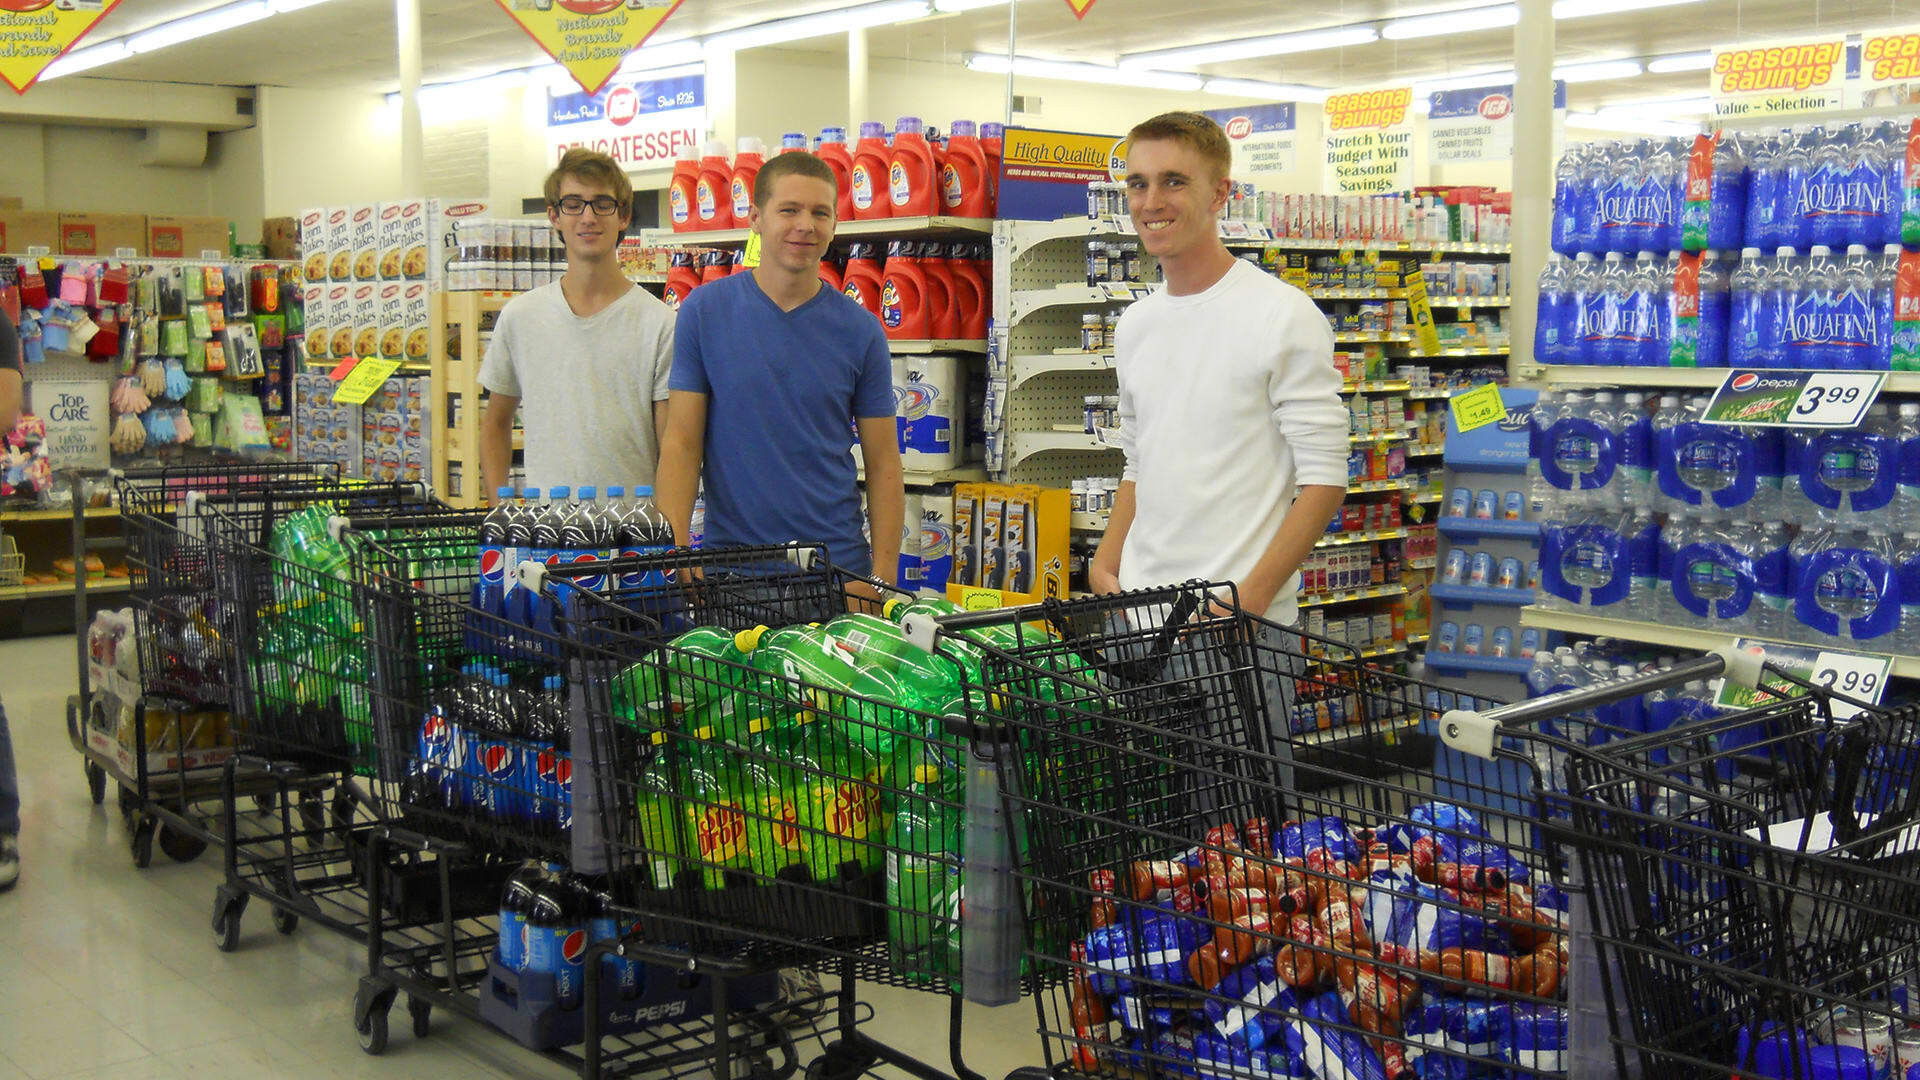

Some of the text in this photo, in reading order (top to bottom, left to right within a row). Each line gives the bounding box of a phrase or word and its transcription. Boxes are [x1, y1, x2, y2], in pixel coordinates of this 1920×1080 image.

[0, 11, 58, 26] ational
[557, 12, 629, 32] National
[0, 27, 52, 42] rands
[565, 28, 623, 46] Brands
[556, 49, 590, 63] And
[1714, 41, 1844, 74] seasonal
[1721, 63, 1833, 93] savings
[657, 91, 695, 109] Since 1926
[1325, 87, 1412, 115] seasonal
[1435, 92, 1443, 106] 2
[1715, 102, 1749, 116] Value
[1765, 96, 1826, 112] Selection
[1282, 105, 1288, 119] 1
[1483, 101, 1507, 116] IGA
[1330, 104, 1406, 131] savings
[1227, 120, 1250, 136] IGA
[1432, 126, 1492, 138] CANNED VEGETABLES
[1242, 141, 1276, 152] INTERNATIONAL
[1327, 132, 1411, 149] Stretch Your
[1438, 137, 1483, 149] CANNED FRUITS
[1014, 142, 1105, 168] High Quality
[1327, 145, 1409, 165] Budget With
[1438, 149, 1482, 160] DOLLAR DEALS
[1021, 169, 1030, 177] AND
[1031, 170, 1049, 178] NATURAL
[1050, 171, 1076, 180] NUTRITIONAL
[1077, 173, 1105, 181] SUPPLEMENTS
[1250, 163, 1282, 172] CONDIMENTS
[1336, 162, 1397, 177] Seasonal
[1340, 178, 1393, 193] Savings
[1692, 178, 1708, 195] 24
[1794, 175, 1889, 217] AQUAFINA
[1592, 189, 1673, 226] AQUAFINA
[305, 225, 321, 238] corn
[331, 223, 347, 237] corn
[355, 221, 372, 236] corn
[383, 219, 401, 233] corn
[404, 217, 421, 231] corn
[303, 236, 325, 253] flakes
[329, 235, 349, 252] flakes
[353, 232, 376, 251] flakes
[379, 231, 400, 251] flake
[401, 228, 424, 249] flakes
[307, 299, 323, 312] corn
[331, 299, 349, 313] corn
[356, 298, 373, 312] corn
[383, 297, 400, 312] corn
[407, 297, 425, 311] corn
[1679, 296, 1695, 311] 24
[1899, 296, 1920, 314] 24
[305, 312, 325, 328] flakes
[329, 311, 351, 328] flakes
[353, 310, 376, 327] flakes
[379, 309, 403, 327] flakes
[404, 309, 427, 328] flakes
[1575, 302, 1660, 340] AQUAFINA
[1780, 304, 1878, 346] AQUAFINA
[1756, 378, 1798, 389] pepsi
[59, 393, 84, 408] TOP
[50, 404, 90, 422] CARE
[699, 821, 743, 856] Drop
[561, 969, 570, 998] next
[635, 1001, 686, 1023] PEPSI
